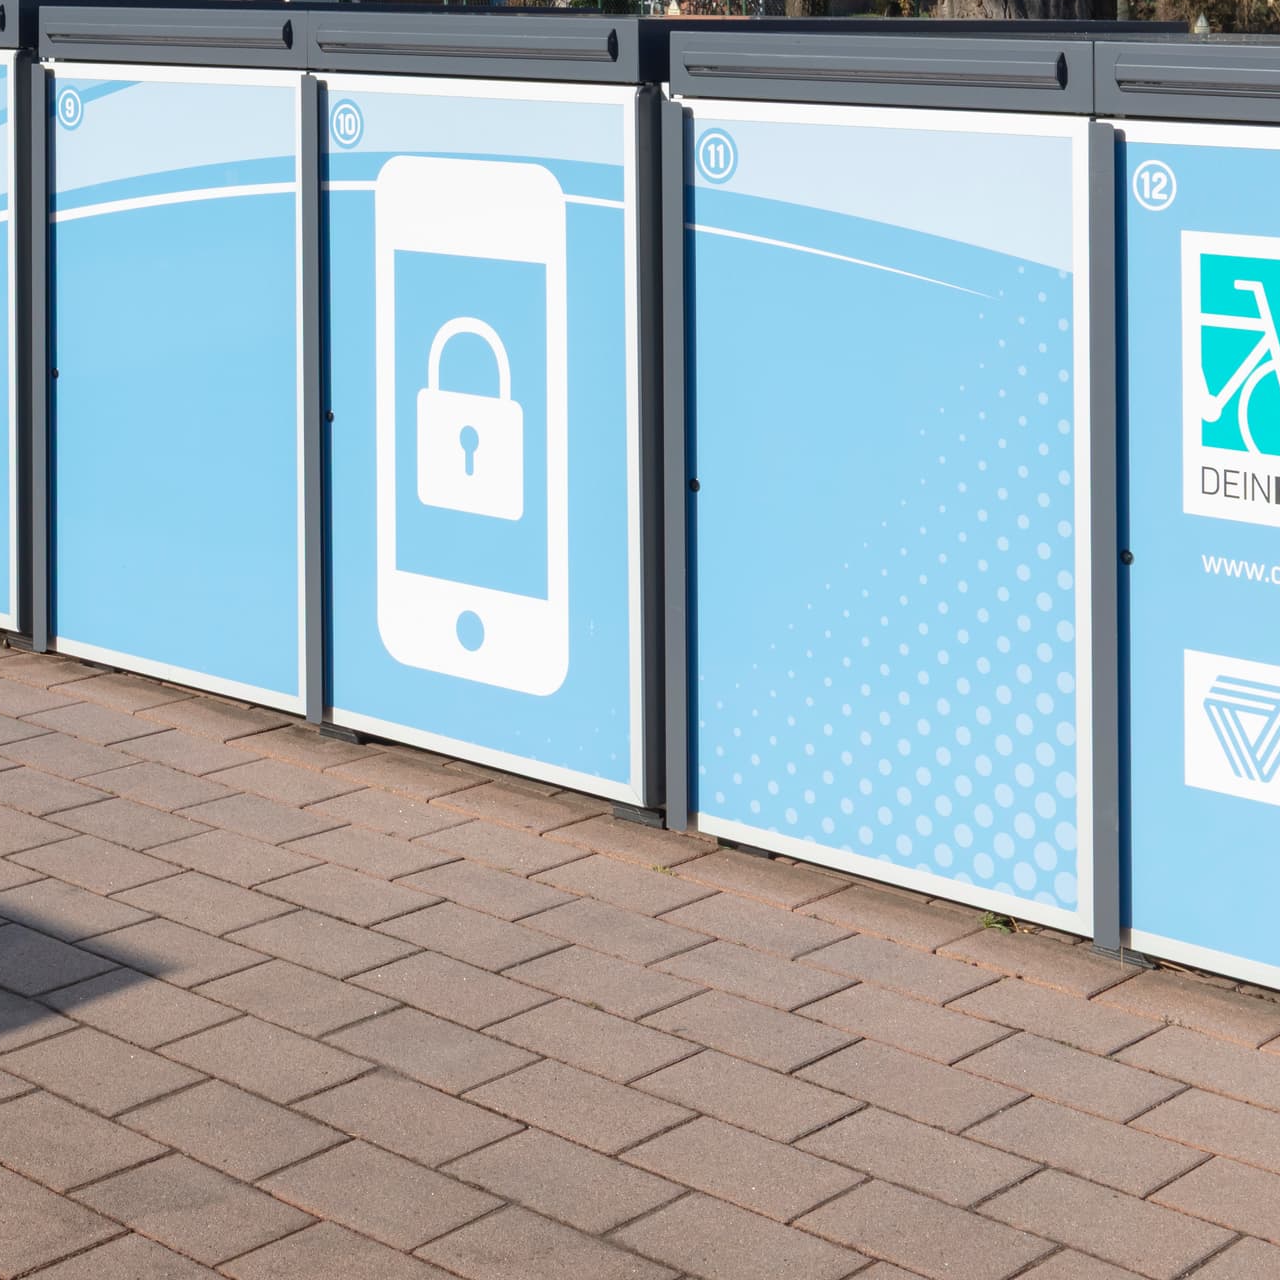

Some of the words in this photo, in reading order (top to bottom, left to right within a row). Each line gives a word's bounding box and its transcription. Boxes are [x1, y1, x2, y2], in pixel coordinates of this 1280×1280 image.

[65, 98, 74, 118] 9
[338, 113, 355, 135] 10
[707, 143, 725, 169] 11
[1140, 170, 1168, 200] 12
